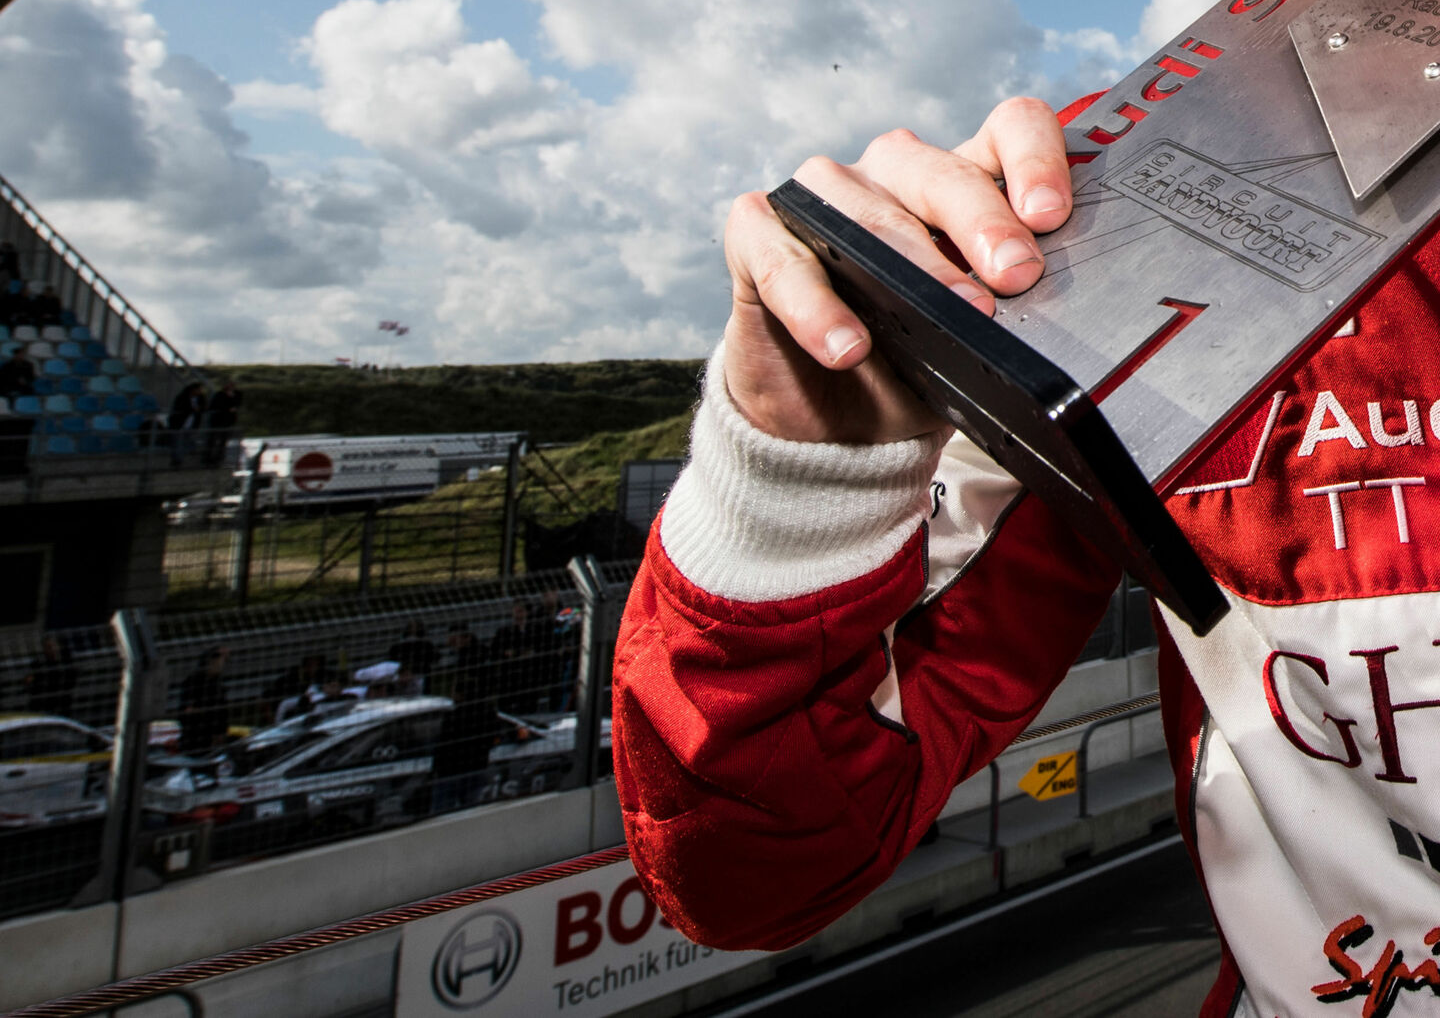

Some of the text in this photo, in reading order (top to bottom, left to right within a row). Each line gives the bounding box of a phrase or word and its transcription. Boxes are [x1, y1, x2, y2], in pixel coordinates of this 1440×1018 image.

[1120, 163, 1333, 273] ZANDVOORT
[1151, 152, 1351, 248] CIRCUIT
[1088, 296, 1210, 406] 1
[1303, 476, 1426, 550] TT
[1037, 759, 1058, 775] DIR
[1052, 778, 1076, 793] ENG
[553, 939, 714, 1011] Technik fürs
